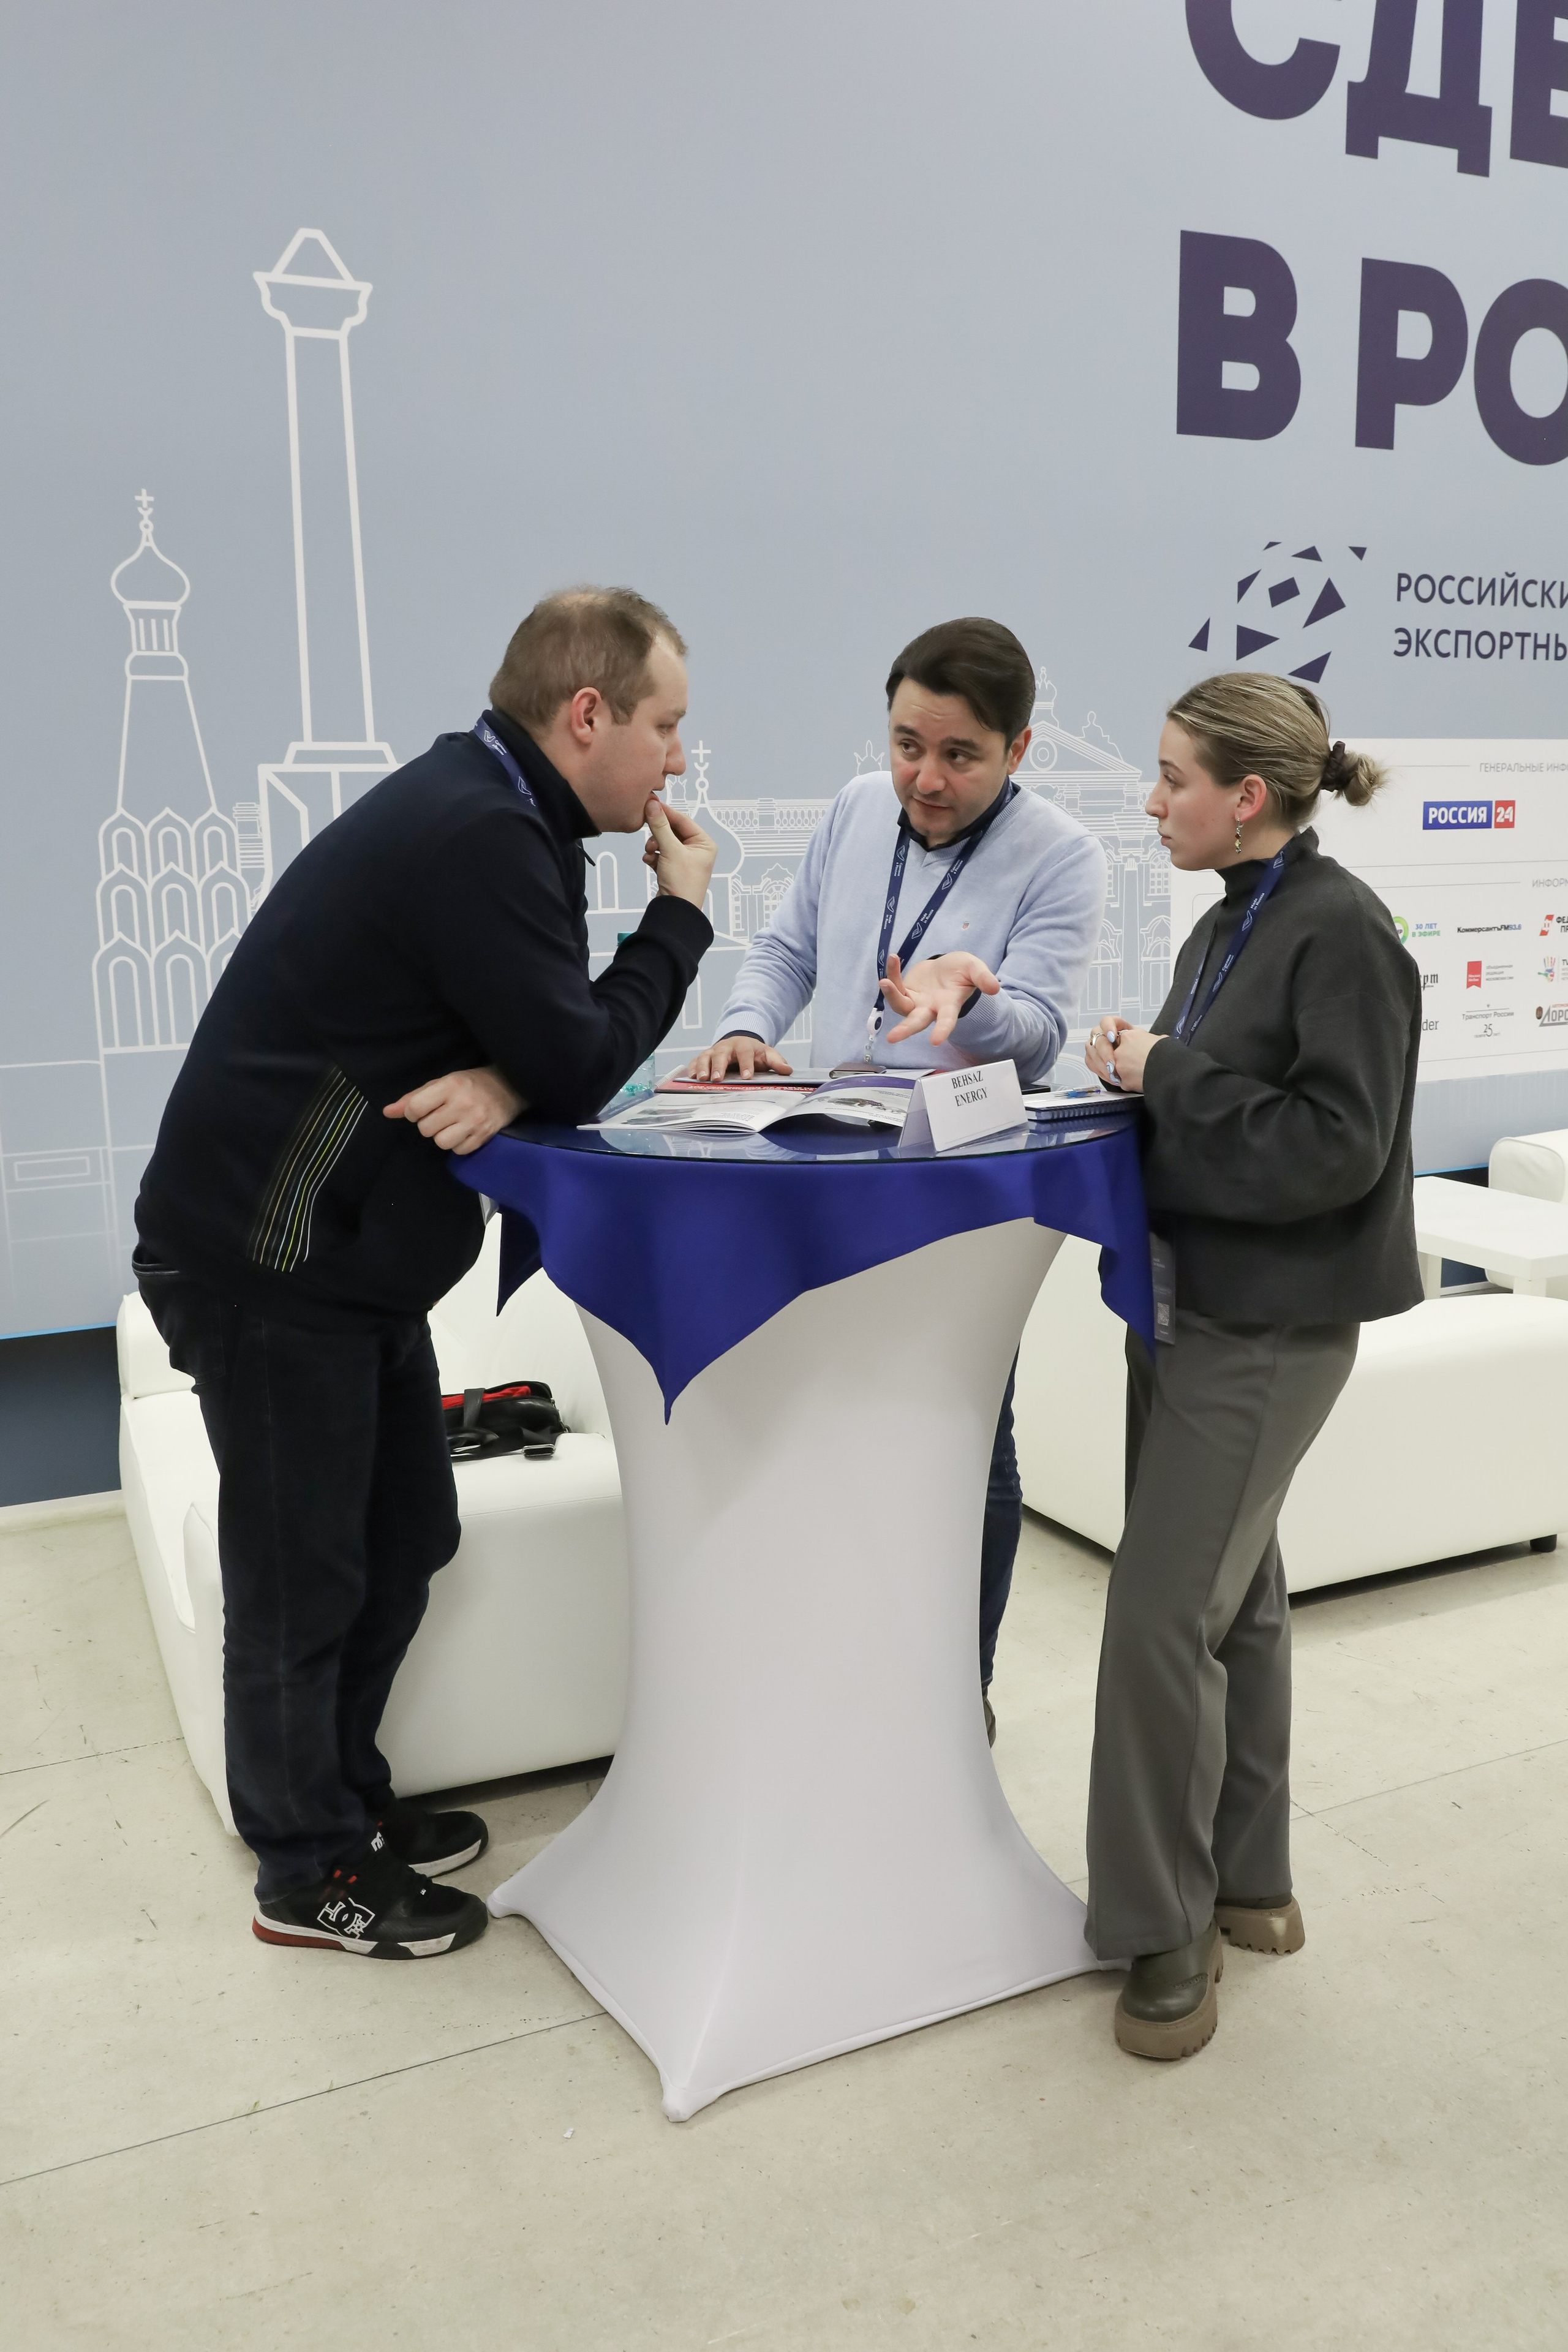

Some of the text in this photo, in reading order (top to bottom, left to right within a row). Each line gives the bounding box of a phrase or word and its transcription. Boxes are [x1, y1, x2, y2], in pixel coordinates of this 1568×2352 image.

[1177, 230, 1302, 441] В
[1479, 763, 1544, 772] ГЕНЕРАЛЬНЫЕ
[1428, 806, 1513, 824] РОССИЯ 24
[1483, 1023, 1493, 1037] 25
[951, 1070, 984, 1089] BEHSAZ
[954, 1087, 987, 1107] ENERGY
